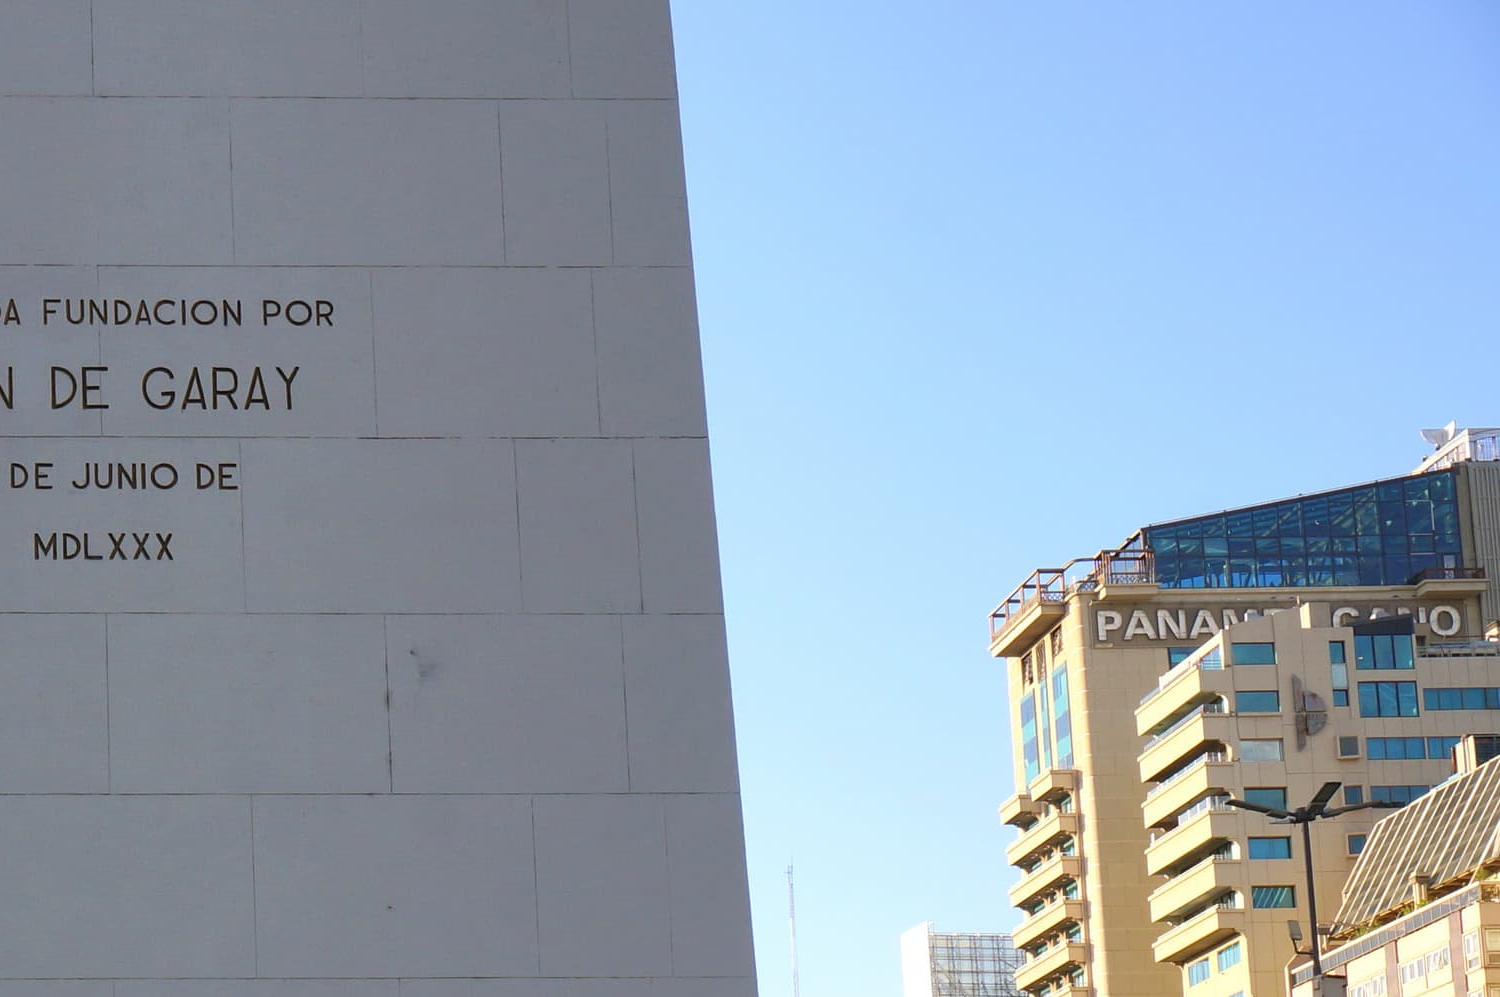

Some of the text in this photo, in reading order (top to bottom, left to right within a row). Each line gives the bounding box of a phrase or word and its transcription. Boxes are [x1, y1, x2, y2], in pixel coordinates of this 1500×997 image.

[42, 298, 243, 327] FUNDACION
[263, 299, 335, 327] POR
[50, 365, 109, 411] DE
[141, 365, 301, 411] GARAY
[10, 462, 54, 490] DE
[72, 462, 179, 491] JUNIO
[196, 462, 239, 491] DE
[33, 532, 175, 561] MDLXXX
